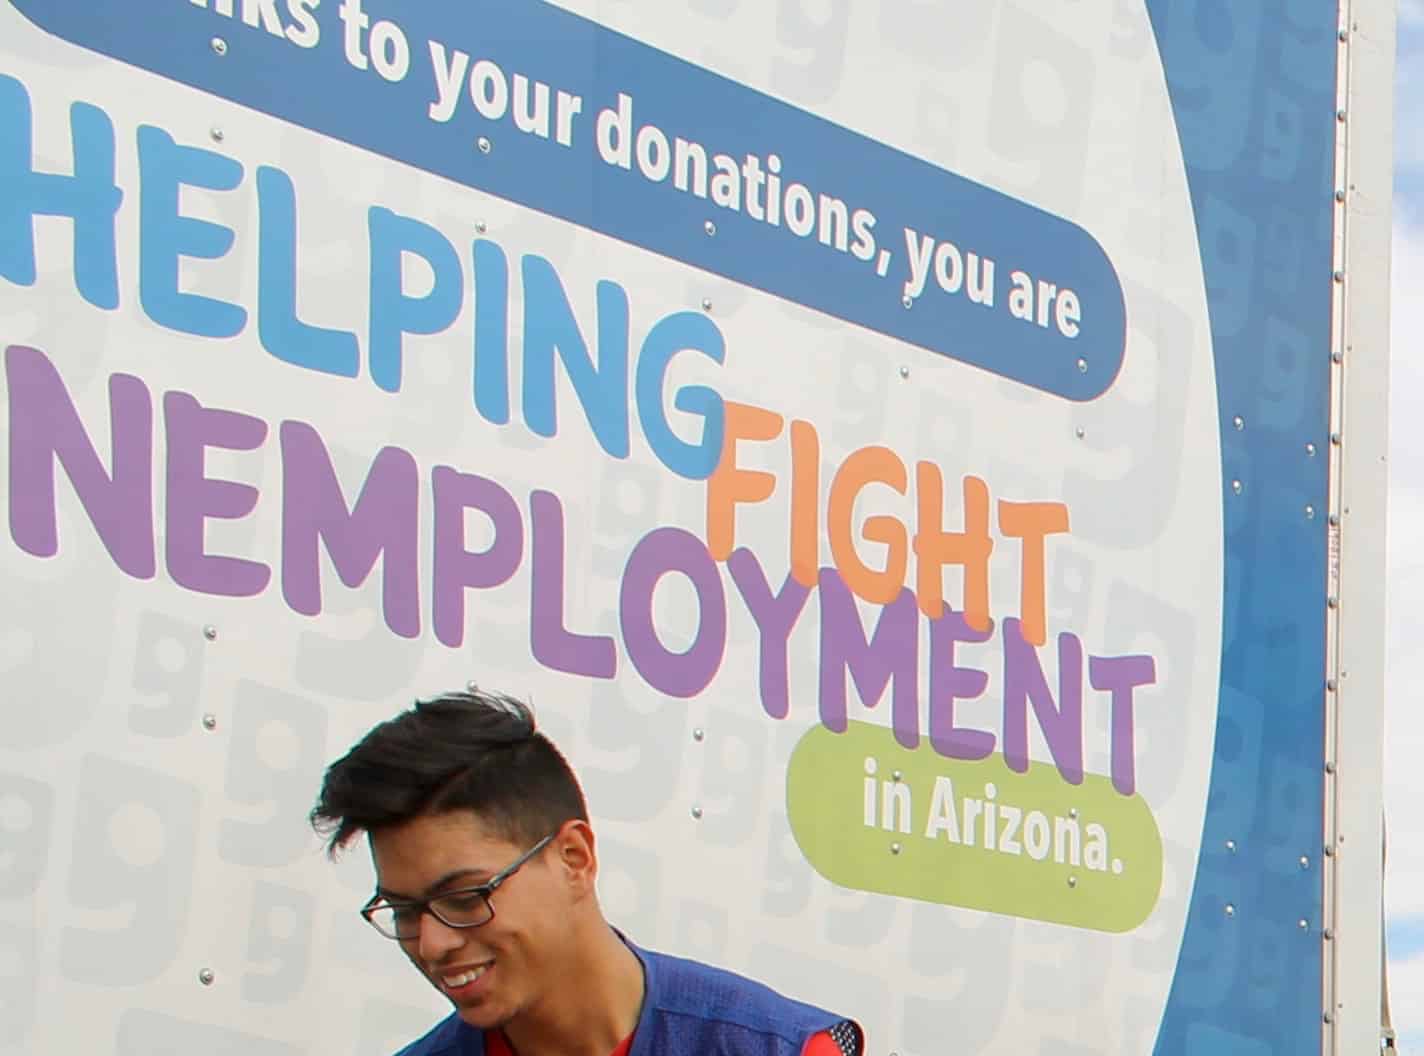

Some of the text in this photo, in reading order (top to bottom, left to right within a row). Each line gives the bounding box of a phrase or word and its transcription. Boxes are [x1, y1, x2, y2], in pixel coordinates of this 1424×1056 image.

[0, 72, 727, 481] HELPING
[339, 0, 410, 82] to
[427, 40, 582, 147] your
[596, 93, 892, 276] donations,
[903, 227, 996, 306] you
[1007, 269, 1081, 338] are
[706, 400, 1070, 648] FIGHT
[863, 756, 1124, 875] in Arizona.
